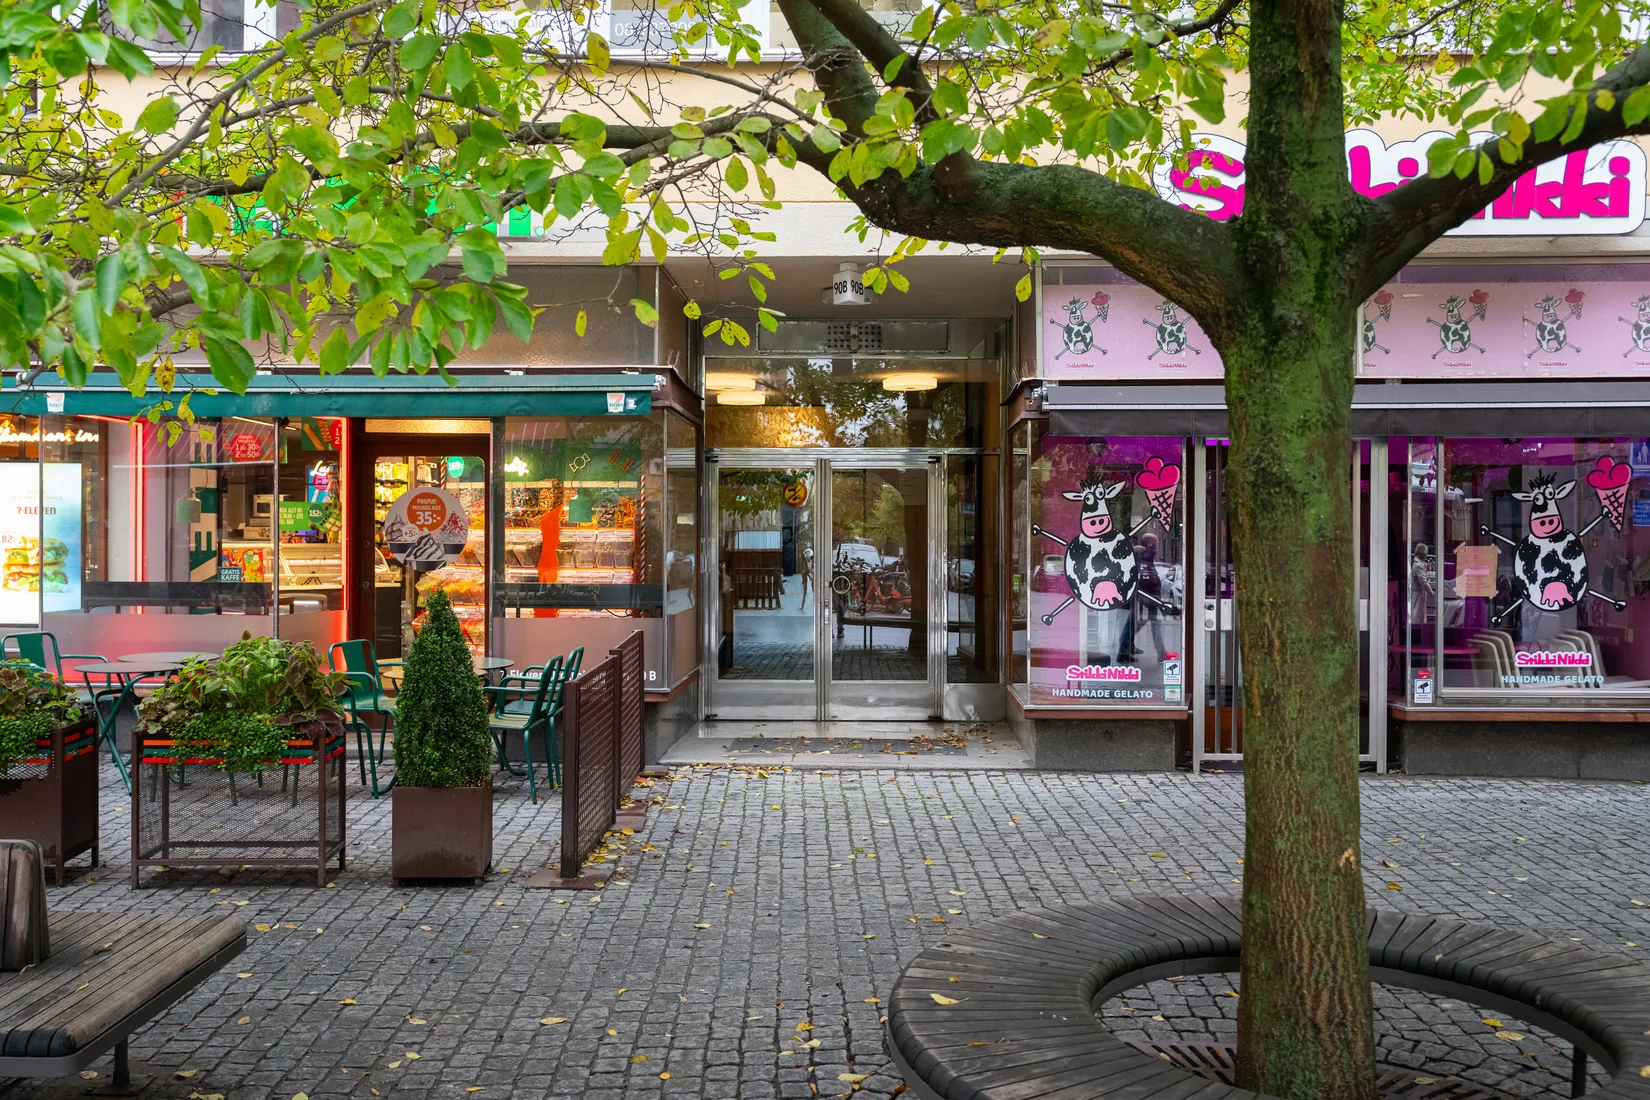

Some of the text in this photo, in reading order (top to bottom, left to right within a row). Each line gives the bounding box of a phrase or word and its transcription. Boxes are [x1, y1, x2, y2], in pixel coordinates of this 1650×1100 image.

[834, 280, 848, 295] 90B
[850, 279, 864, 296] 90B
[415, 511, 441, 525] 35:-
[1501, 675, 1605, 684] HANDMADE GELATO
[1052, 688, 1153, 699] HANDMADE GELATO
